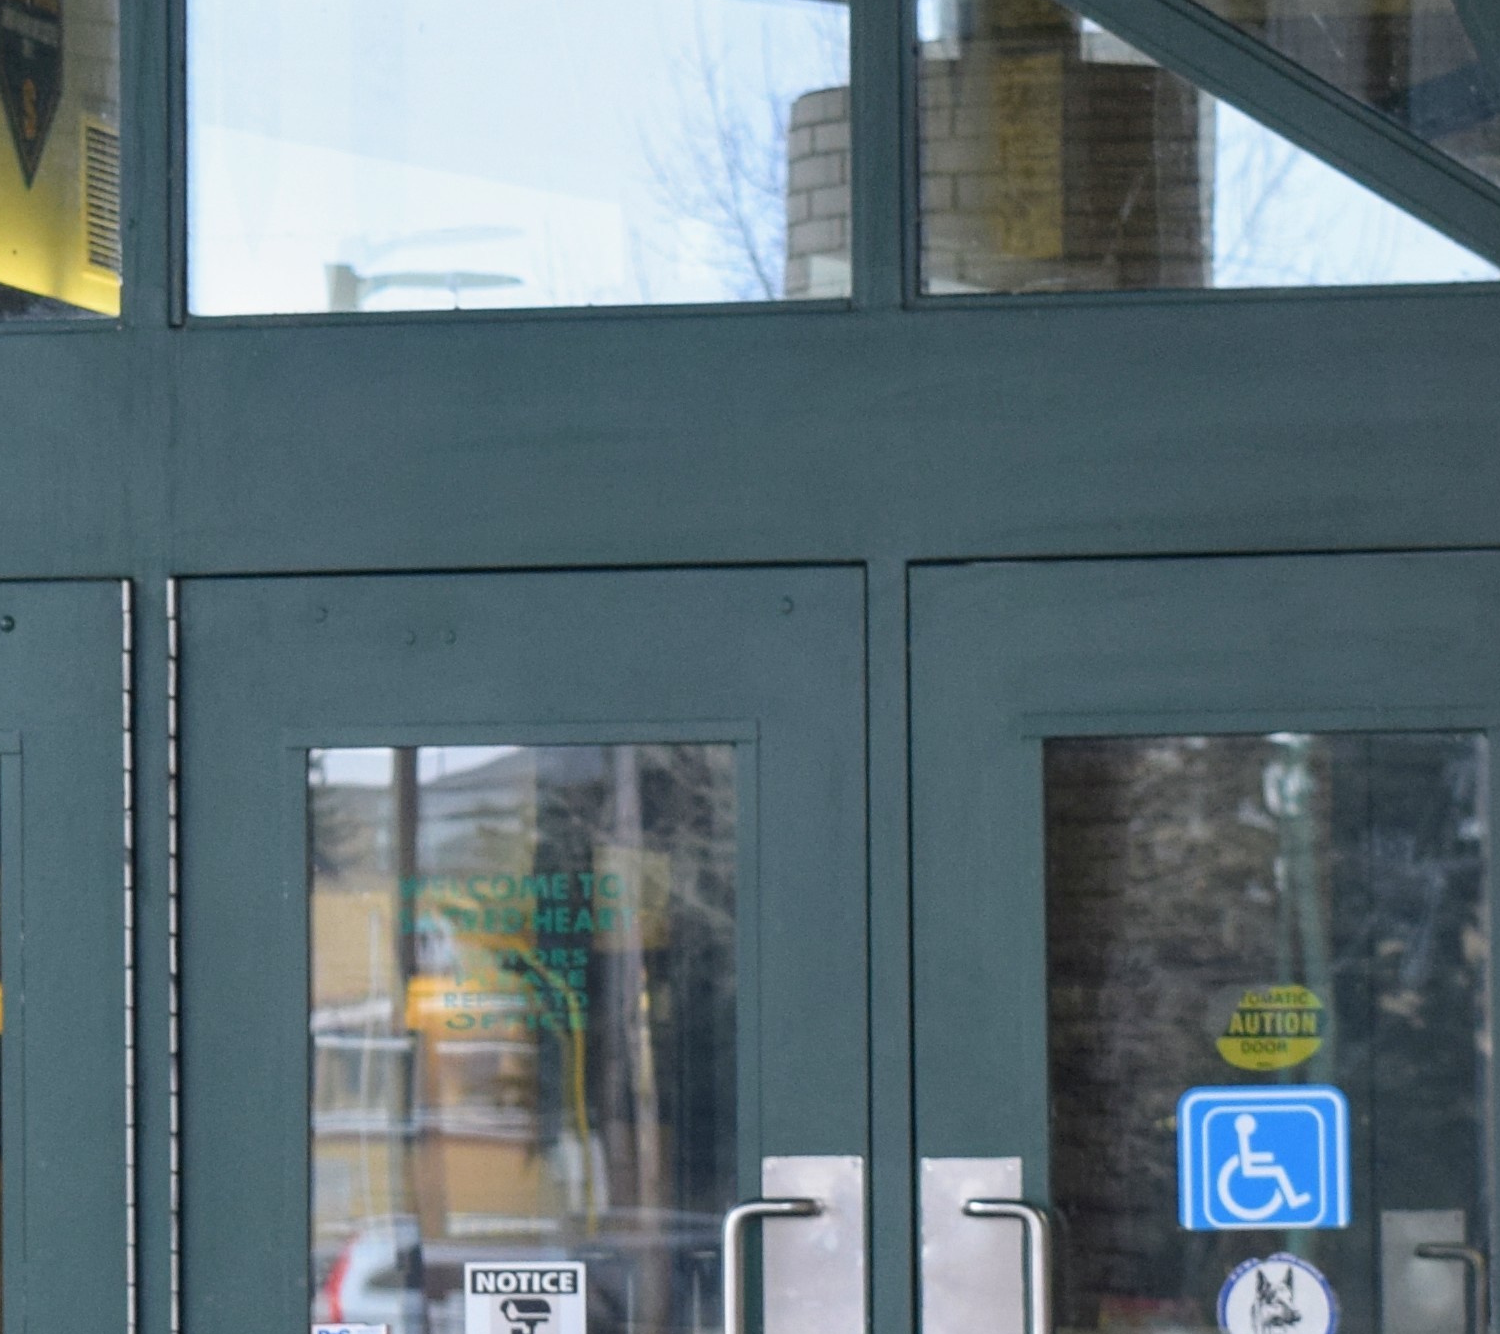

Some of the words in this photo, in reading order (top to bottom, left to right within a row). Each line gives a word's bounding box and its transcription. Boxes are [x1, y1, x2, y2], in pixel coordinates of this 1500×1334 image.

[398, 873, 569, 901] WELCOME
[398, 906, 524, 935] SACRED
[531, 906, 635, 934] HEART
[1229, 1012, 1317, 1034] AUTION
[475, 1271, 575, 1293] NOTICE
